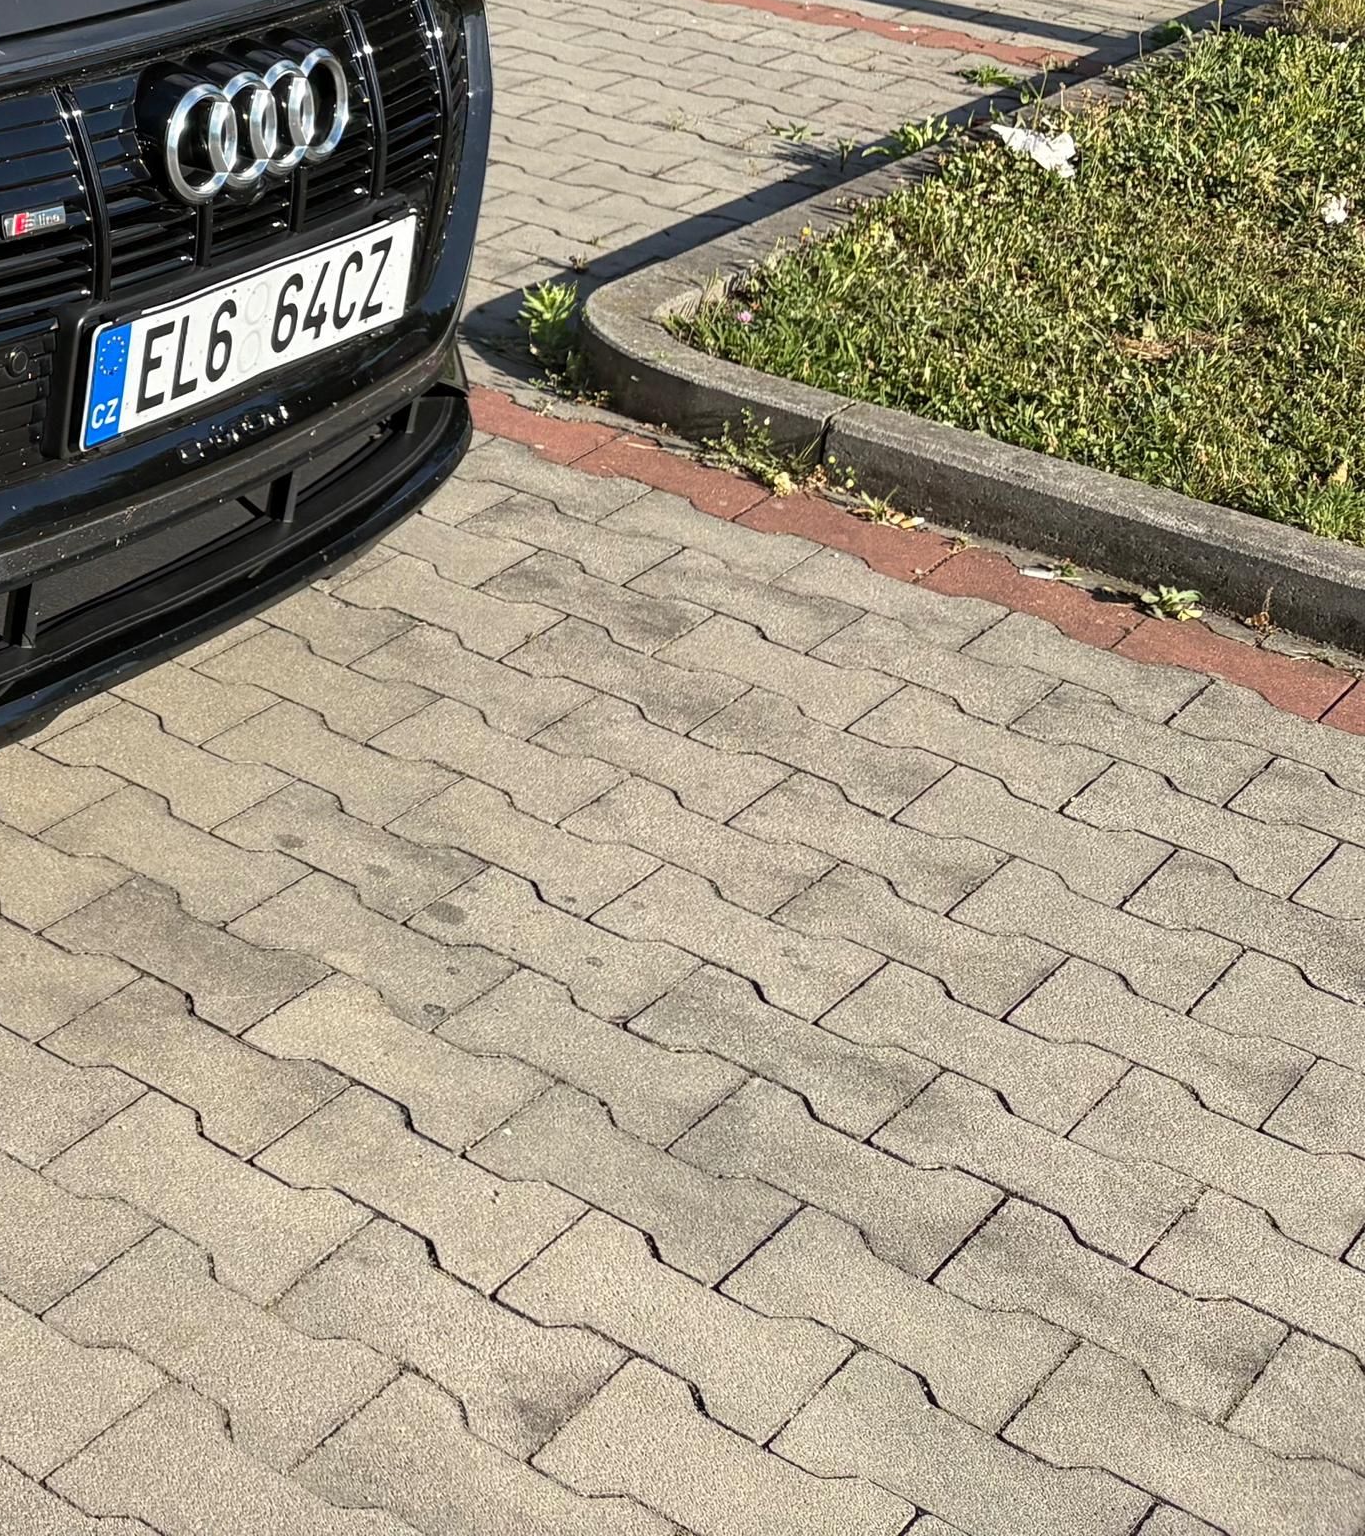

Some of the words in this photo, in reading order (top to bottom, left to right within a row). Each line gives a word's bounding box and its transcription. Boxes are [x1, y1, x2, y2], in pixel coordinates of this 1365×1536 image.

[135, 299, 237, 413] EL6
[271, 236, 394, 354] 64CZ
[90, 396, 119, 430] CZ
